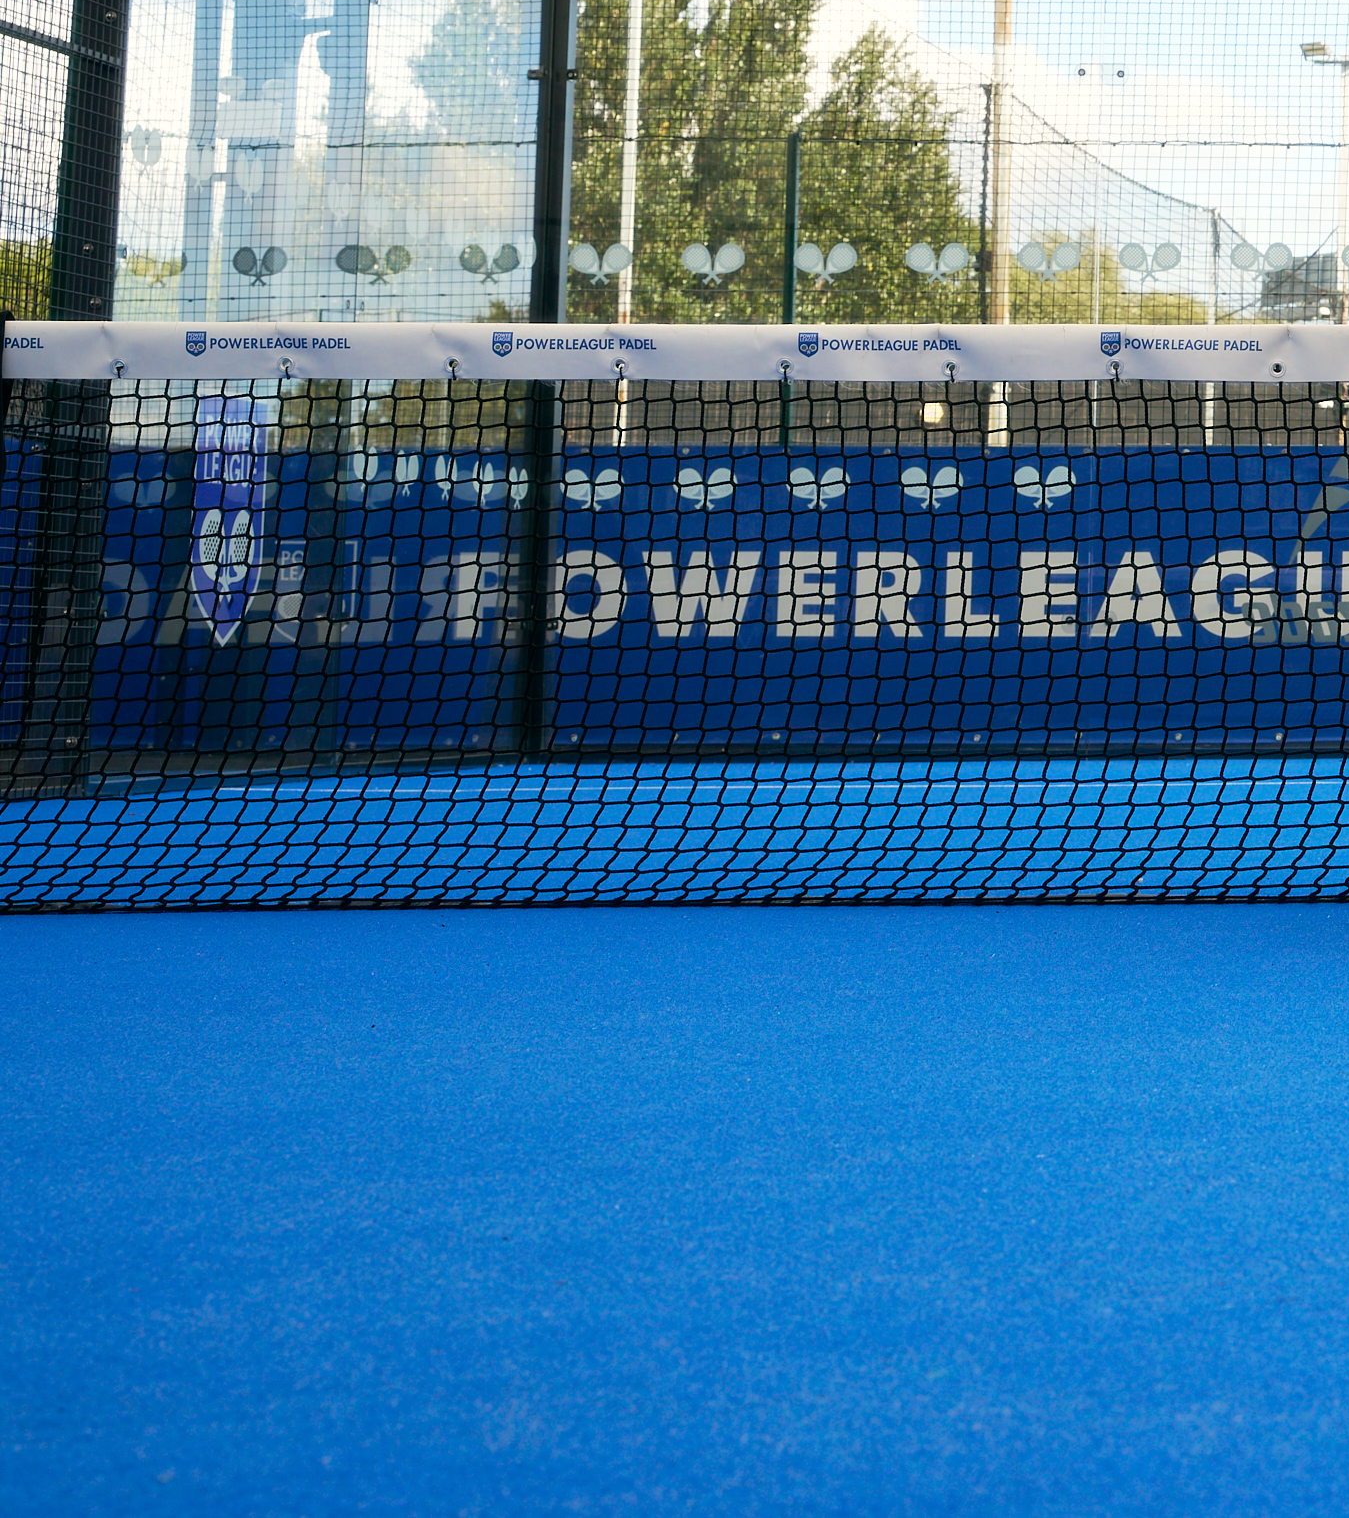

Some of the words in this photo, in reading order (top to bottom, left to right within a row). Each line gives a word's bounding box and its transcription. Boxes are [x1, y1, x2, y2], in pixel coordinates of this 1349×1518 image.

[4, 337, 44, 349] PADEL
[210, 337, 307, 350] POWERLEAGUE
[312, 337, 351, 350] PADEL
[516, 338, 615, 351] POWERLEAGUE
[619, 338, 657, 350] PADEL
[822, 339, 918, 351] POWERLEAGUE
[923, 339, 962, 351] PADEL
[1124, 338, 1219, 351] POWERLEAGUE
[1223, 340, 1263, 352] PADEL
